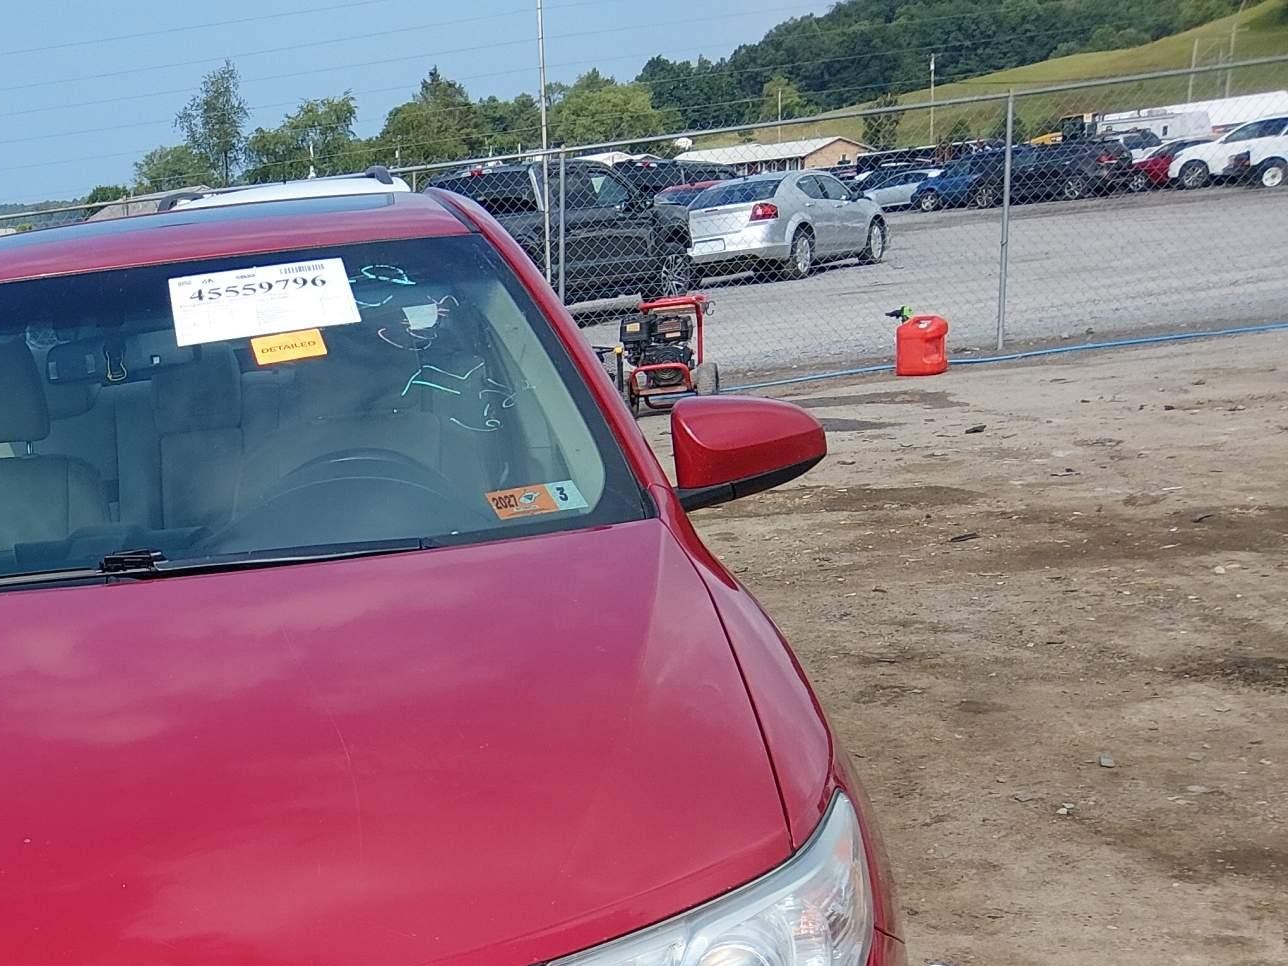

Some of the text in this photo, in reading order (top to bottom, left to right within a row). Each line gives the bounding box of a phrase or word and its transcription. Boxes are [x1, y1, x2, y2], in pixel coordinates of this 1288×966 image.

[189, 273, 327, 302] 45559796
[260, 340, 317, 354] DETAILED
[491, 493, 519, 510] 2027
[554, 486, 569, 502] 3
